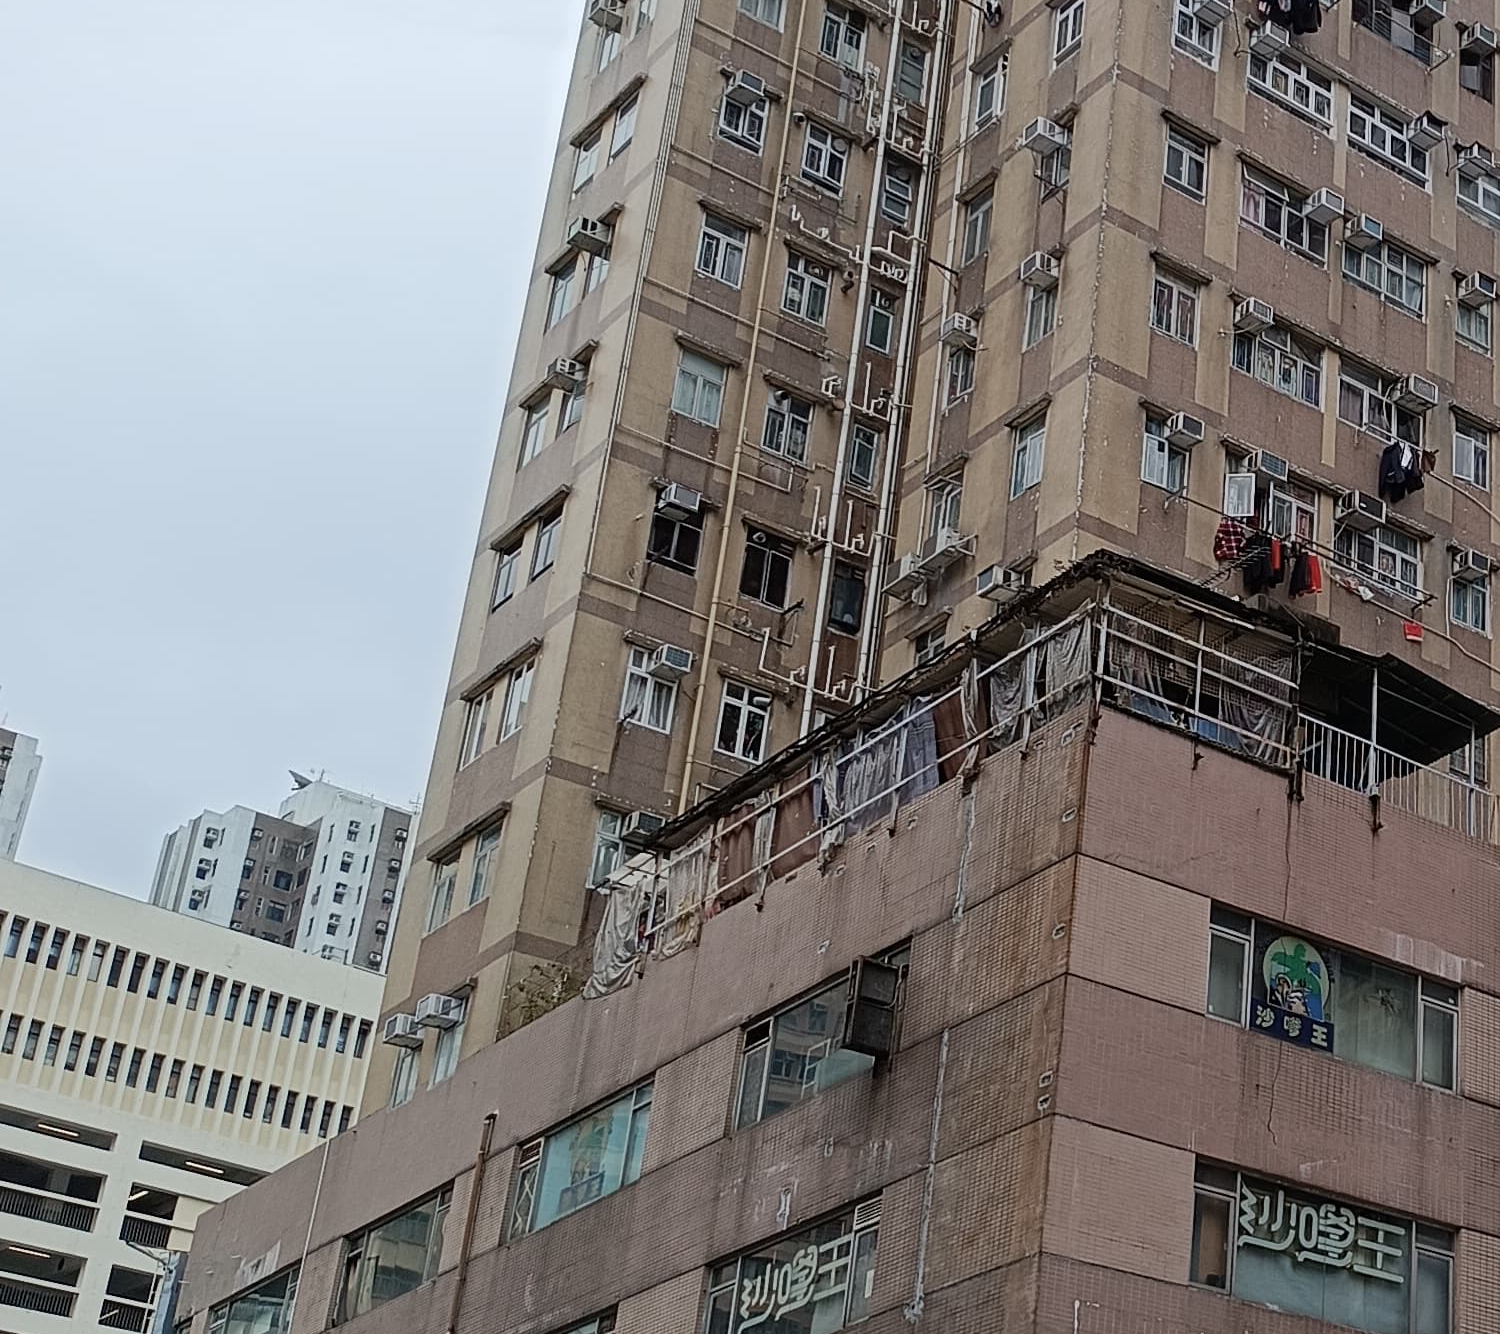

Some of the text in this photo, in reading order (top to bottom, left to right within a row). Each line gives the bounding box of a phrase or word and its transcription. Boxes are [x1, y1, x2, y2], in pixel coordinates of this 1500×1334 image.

[1256, 1005, 1328, 1047] 沙嗲王
[1238, 1181, 1406, 1284] 沙嗲王
